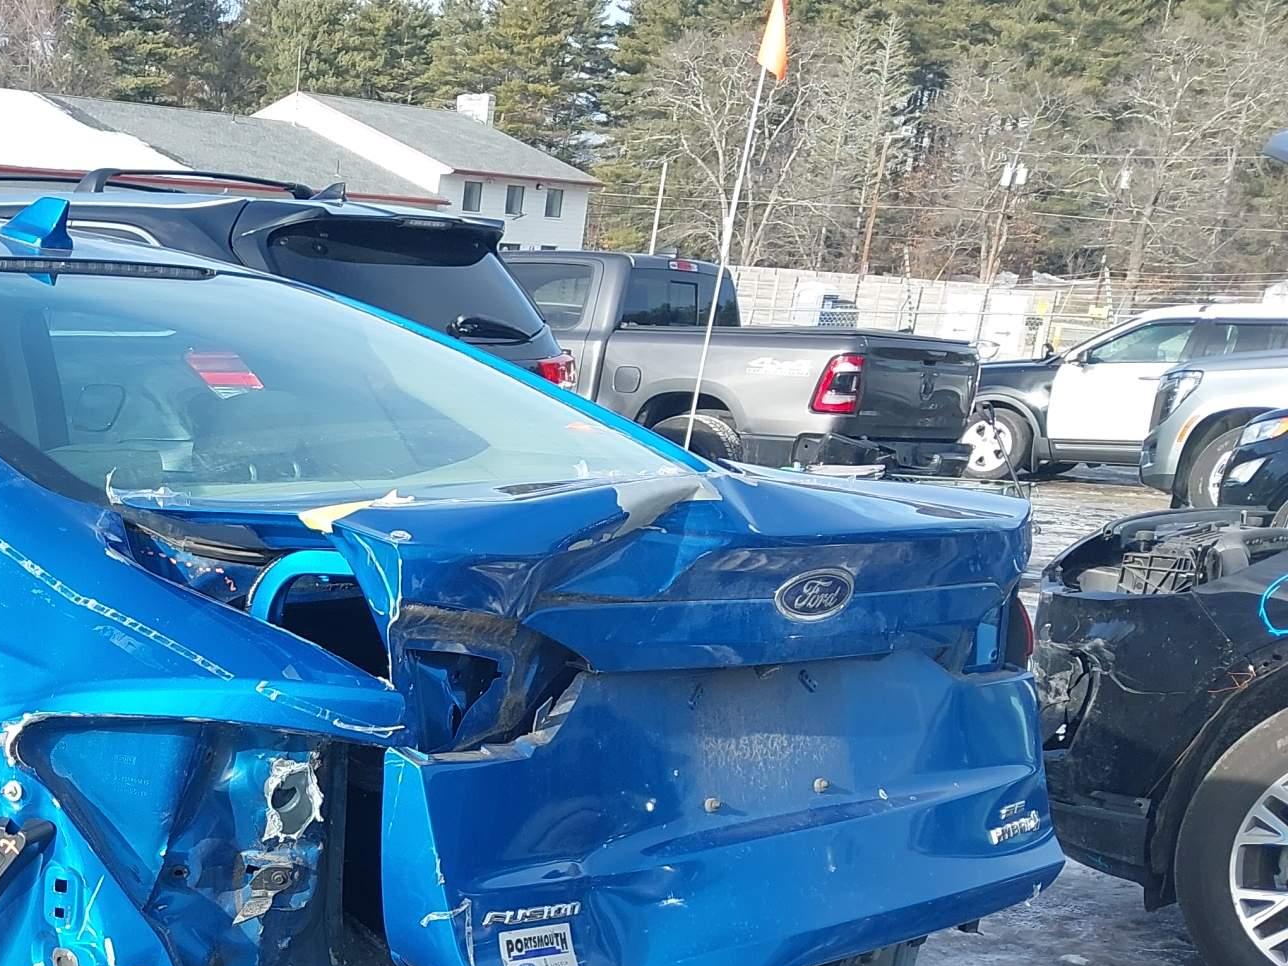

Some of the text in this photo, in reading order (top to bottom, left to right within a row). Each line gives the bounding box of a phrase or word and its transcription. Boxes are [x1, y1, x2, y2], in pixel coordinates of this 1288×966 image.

[794, 579, 842, 610] Ford
[482, 901, 581, 927] FUSION
[506, 931, 569, 958] PORTSMOUTH
